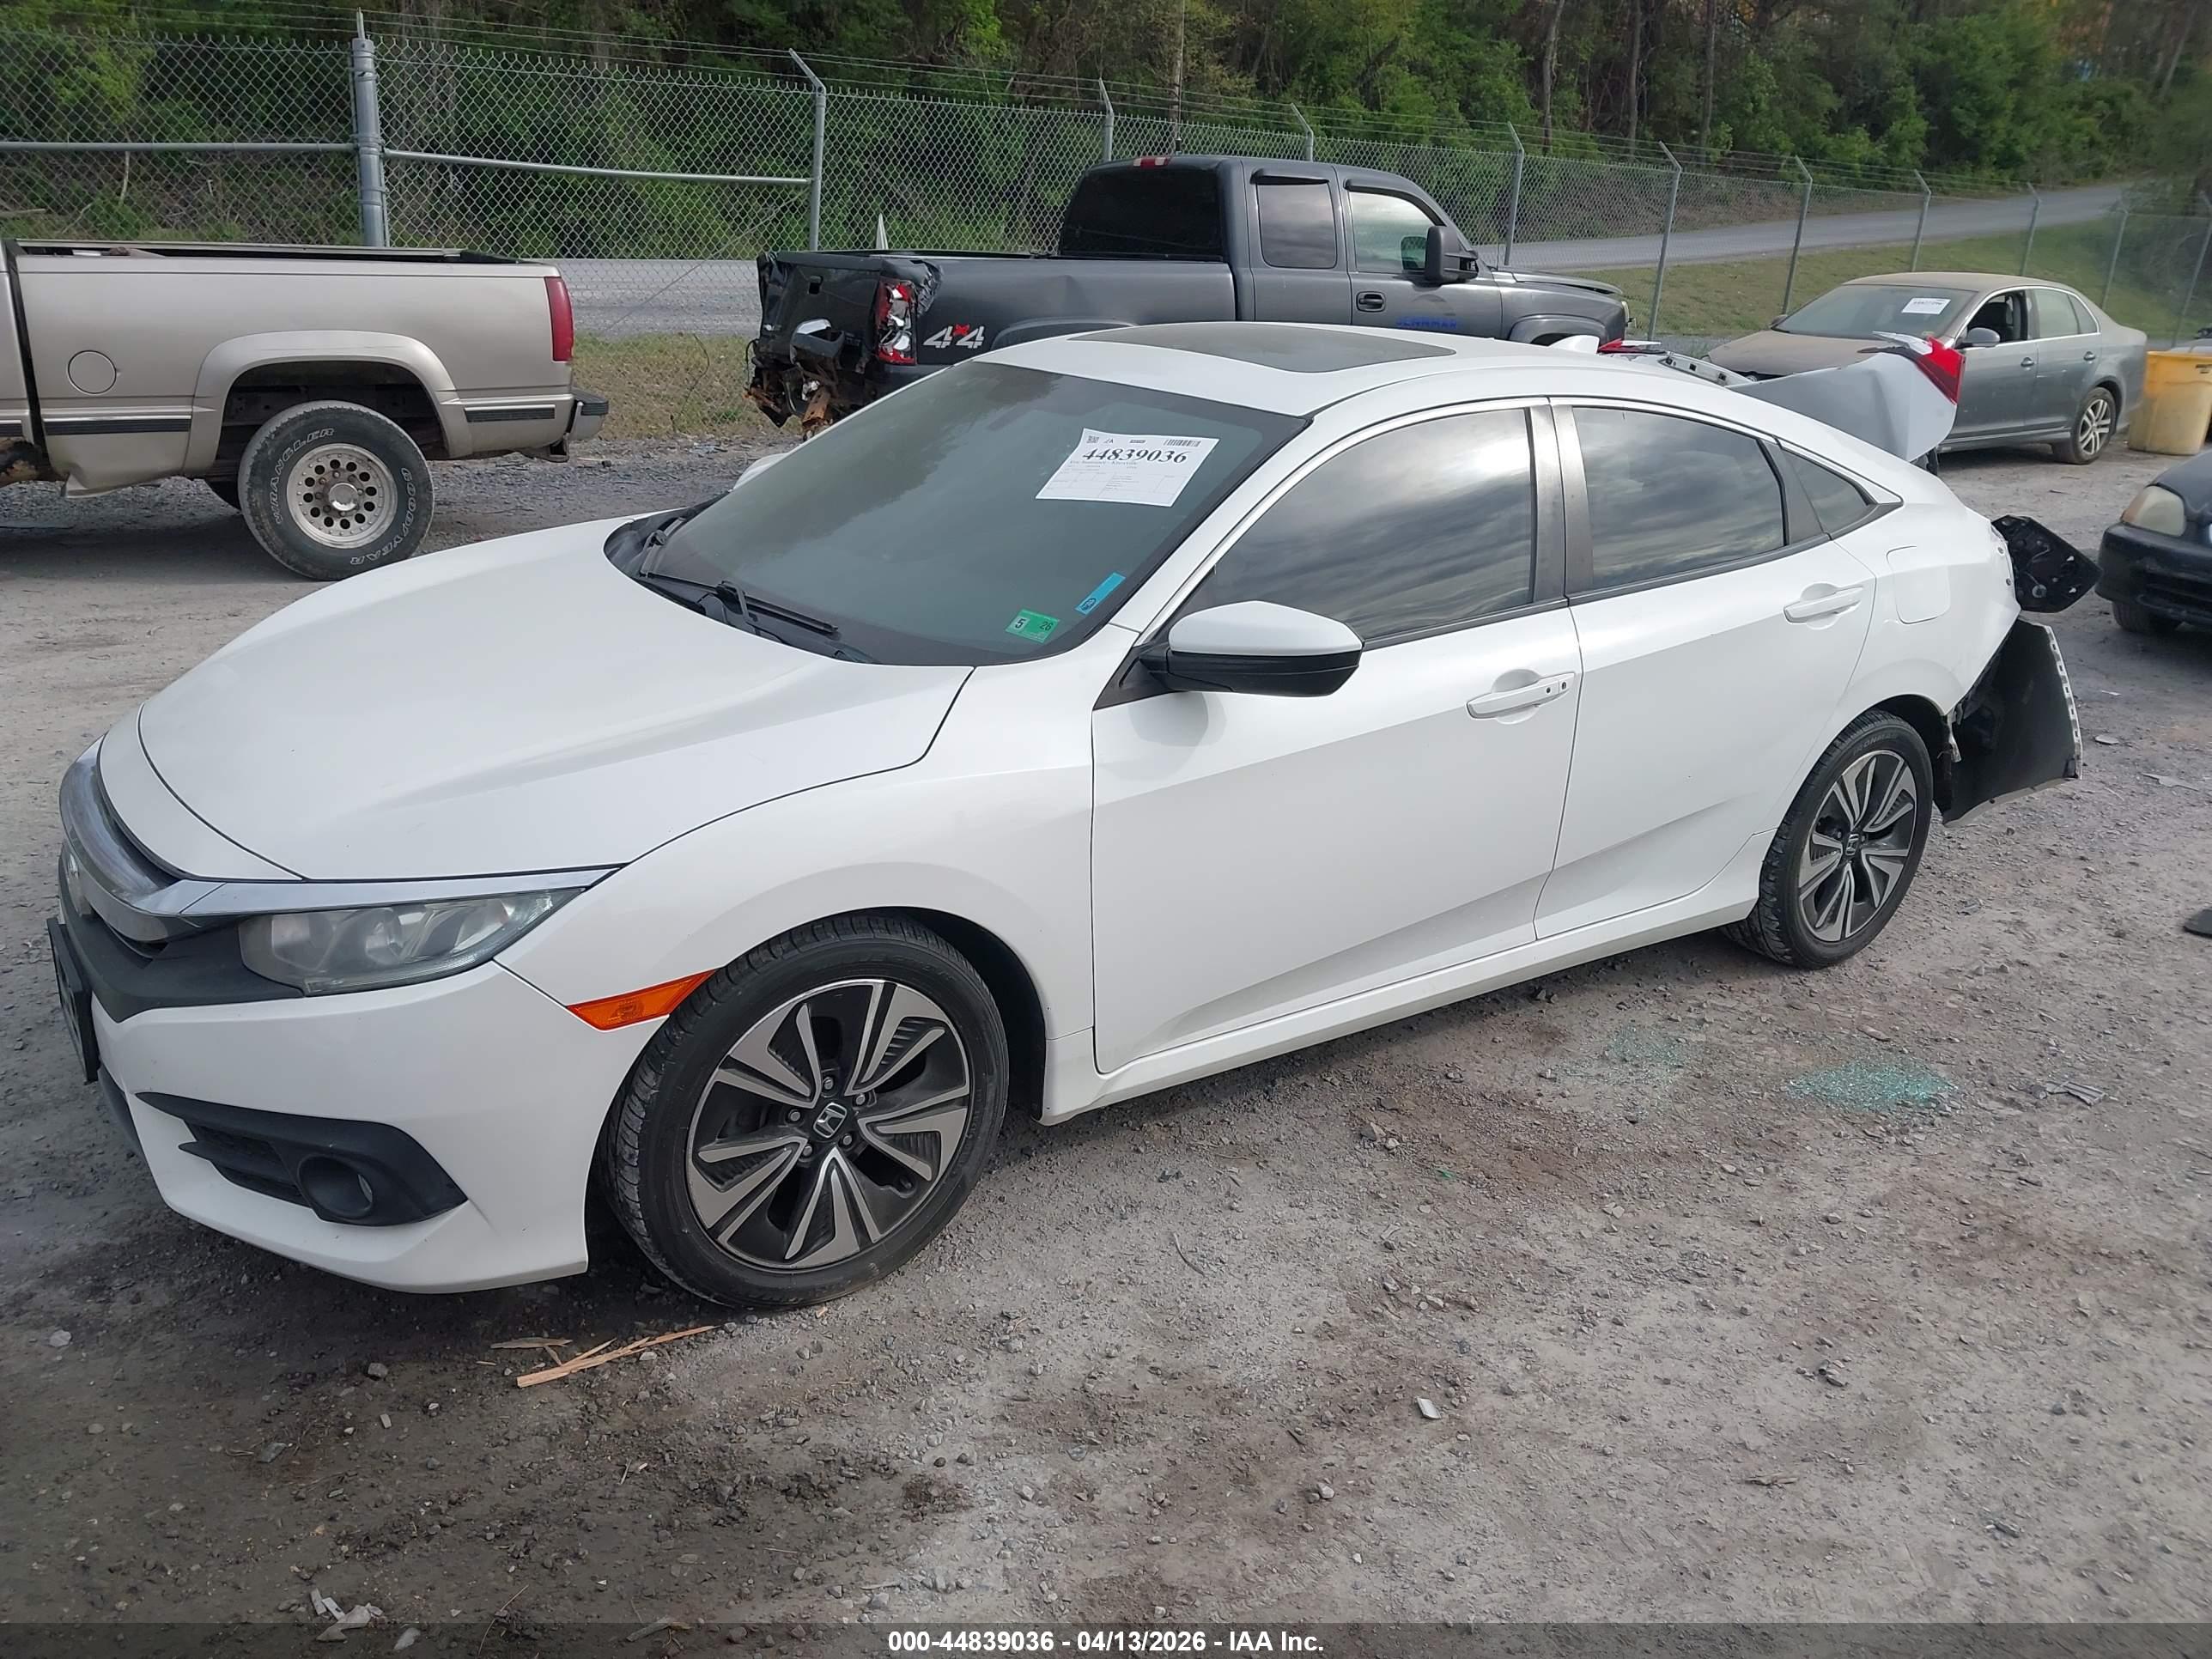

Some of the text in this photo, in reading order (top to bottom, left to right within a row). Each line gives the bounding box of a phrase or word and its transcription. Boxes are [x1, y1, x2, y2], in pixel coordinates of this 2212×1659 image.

[269, 428, 334, 525] WRANGLER
[1083, 447, 1189, 464] 44839036
[350, 467, 416, 565] GOODYEAR
[1015, 618, 1054, 631] 5 26
